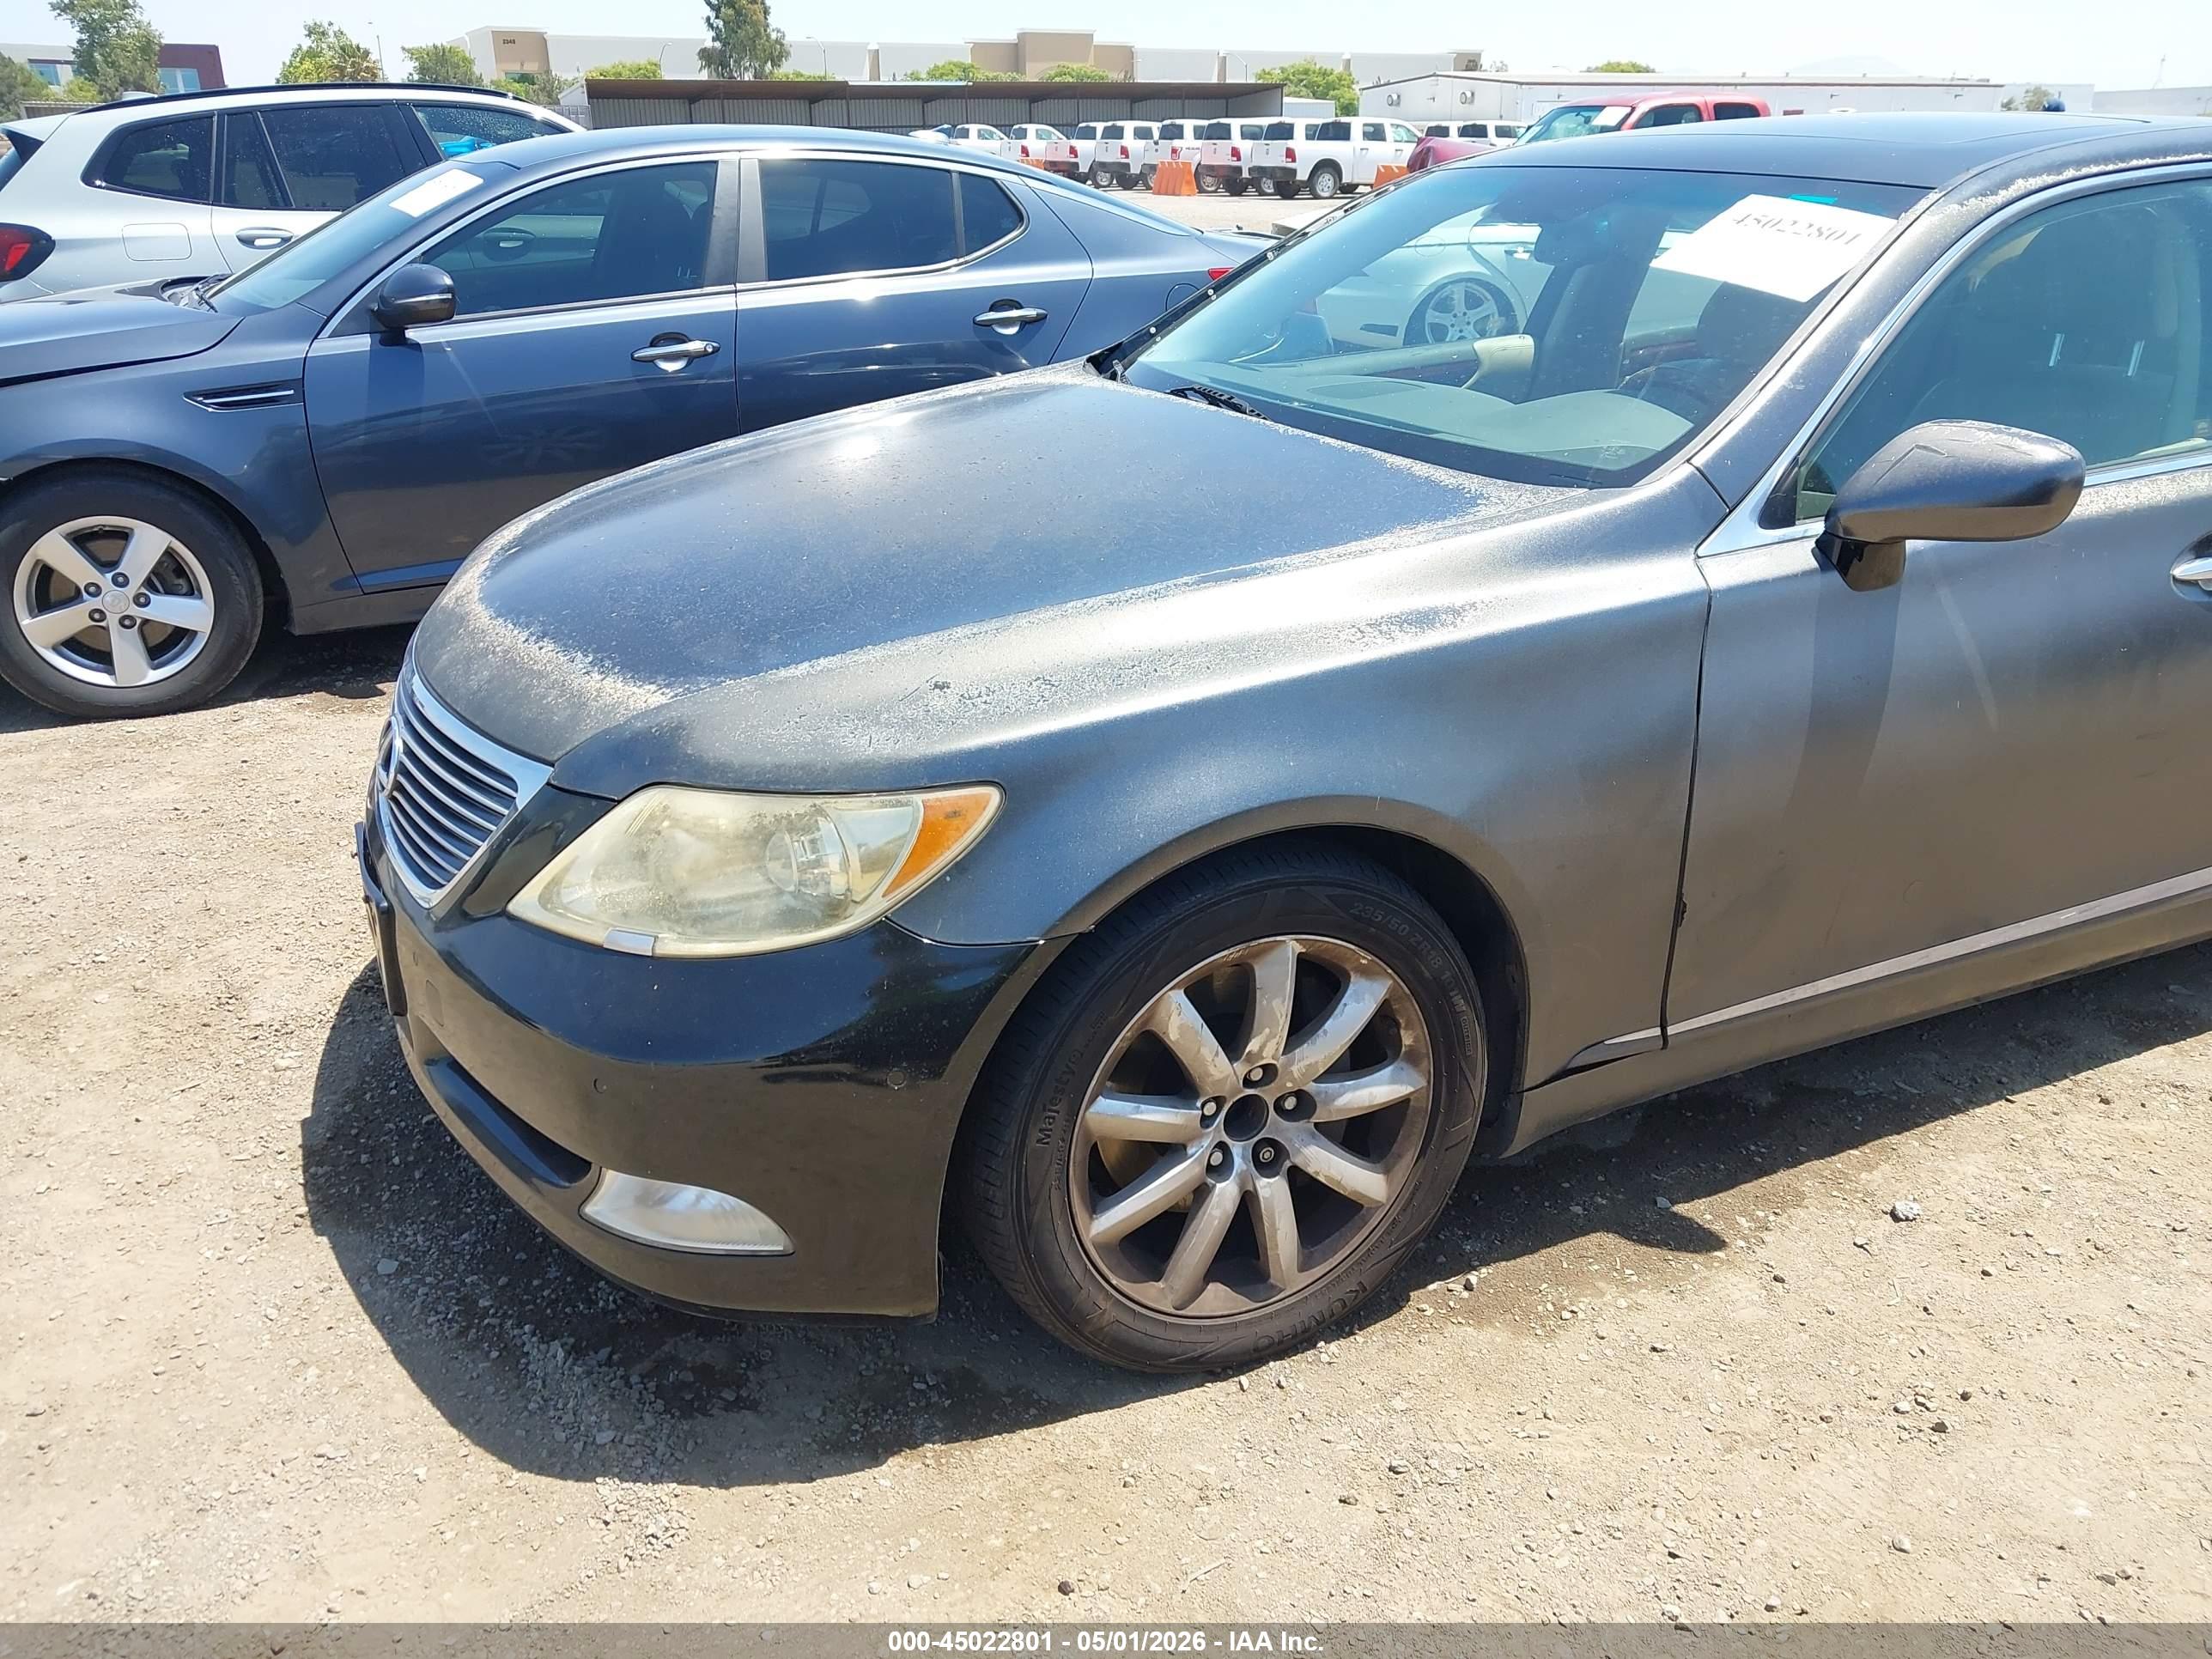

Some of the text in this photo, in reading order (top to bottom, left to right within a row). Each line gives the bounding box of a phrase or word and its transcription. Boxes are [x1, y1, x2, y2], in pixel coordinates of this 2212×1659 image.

[1733, 213, 1863, 245] 45022801
[1349, 902, 1409, 936] 235/50
[1251, 1279, 1369, 1354] KUMHO
